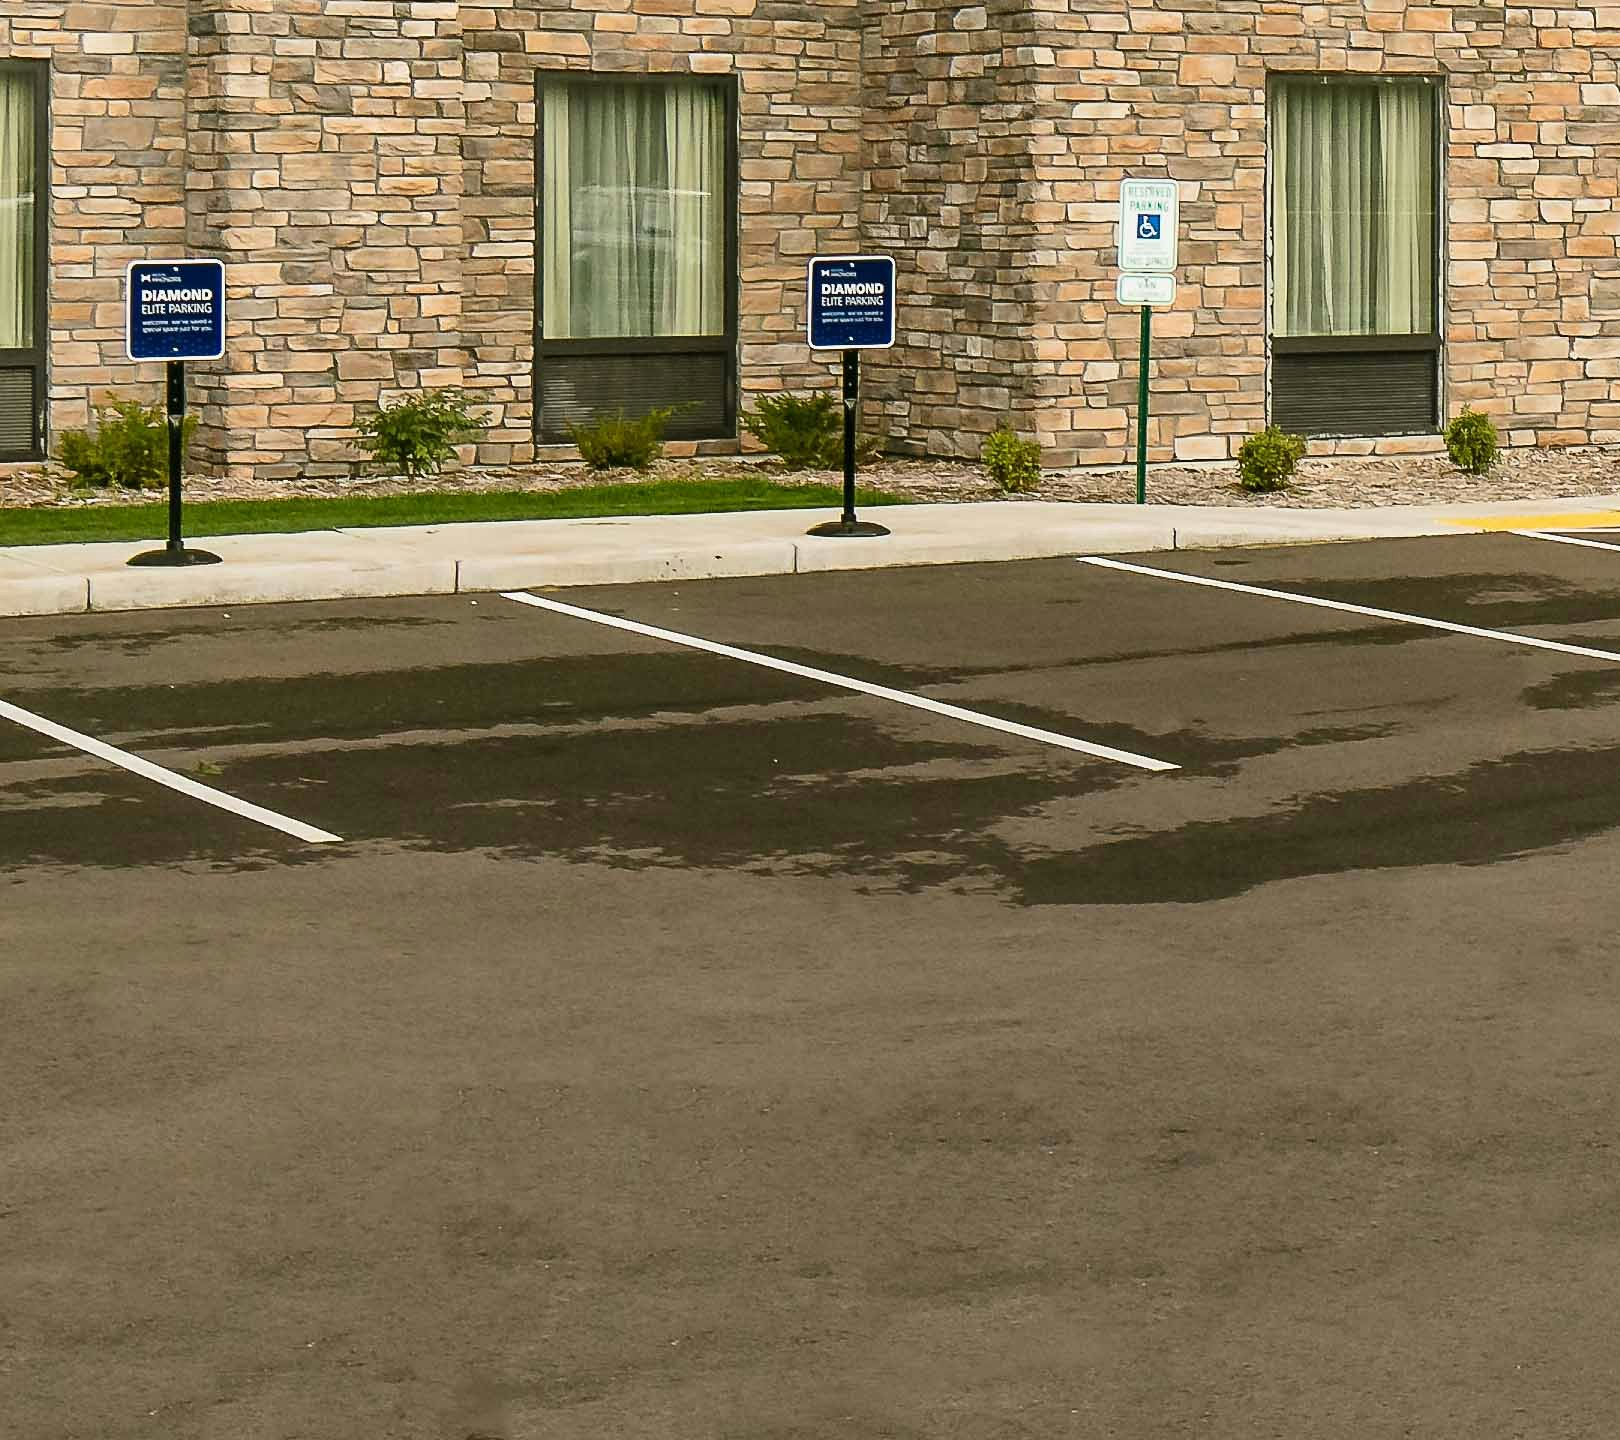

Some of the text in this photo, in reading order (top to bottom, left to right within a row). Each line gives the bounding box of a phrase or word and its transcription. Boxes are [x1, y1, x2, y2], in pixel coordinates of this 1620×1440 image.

[141, 288, 213, 302] DIAMOND
[821, 282, 885, 295] DIAMOND
[821, 295, 884, 307] ELITE PARKING
[141, 302, 213, 315] ELITE PARKING
